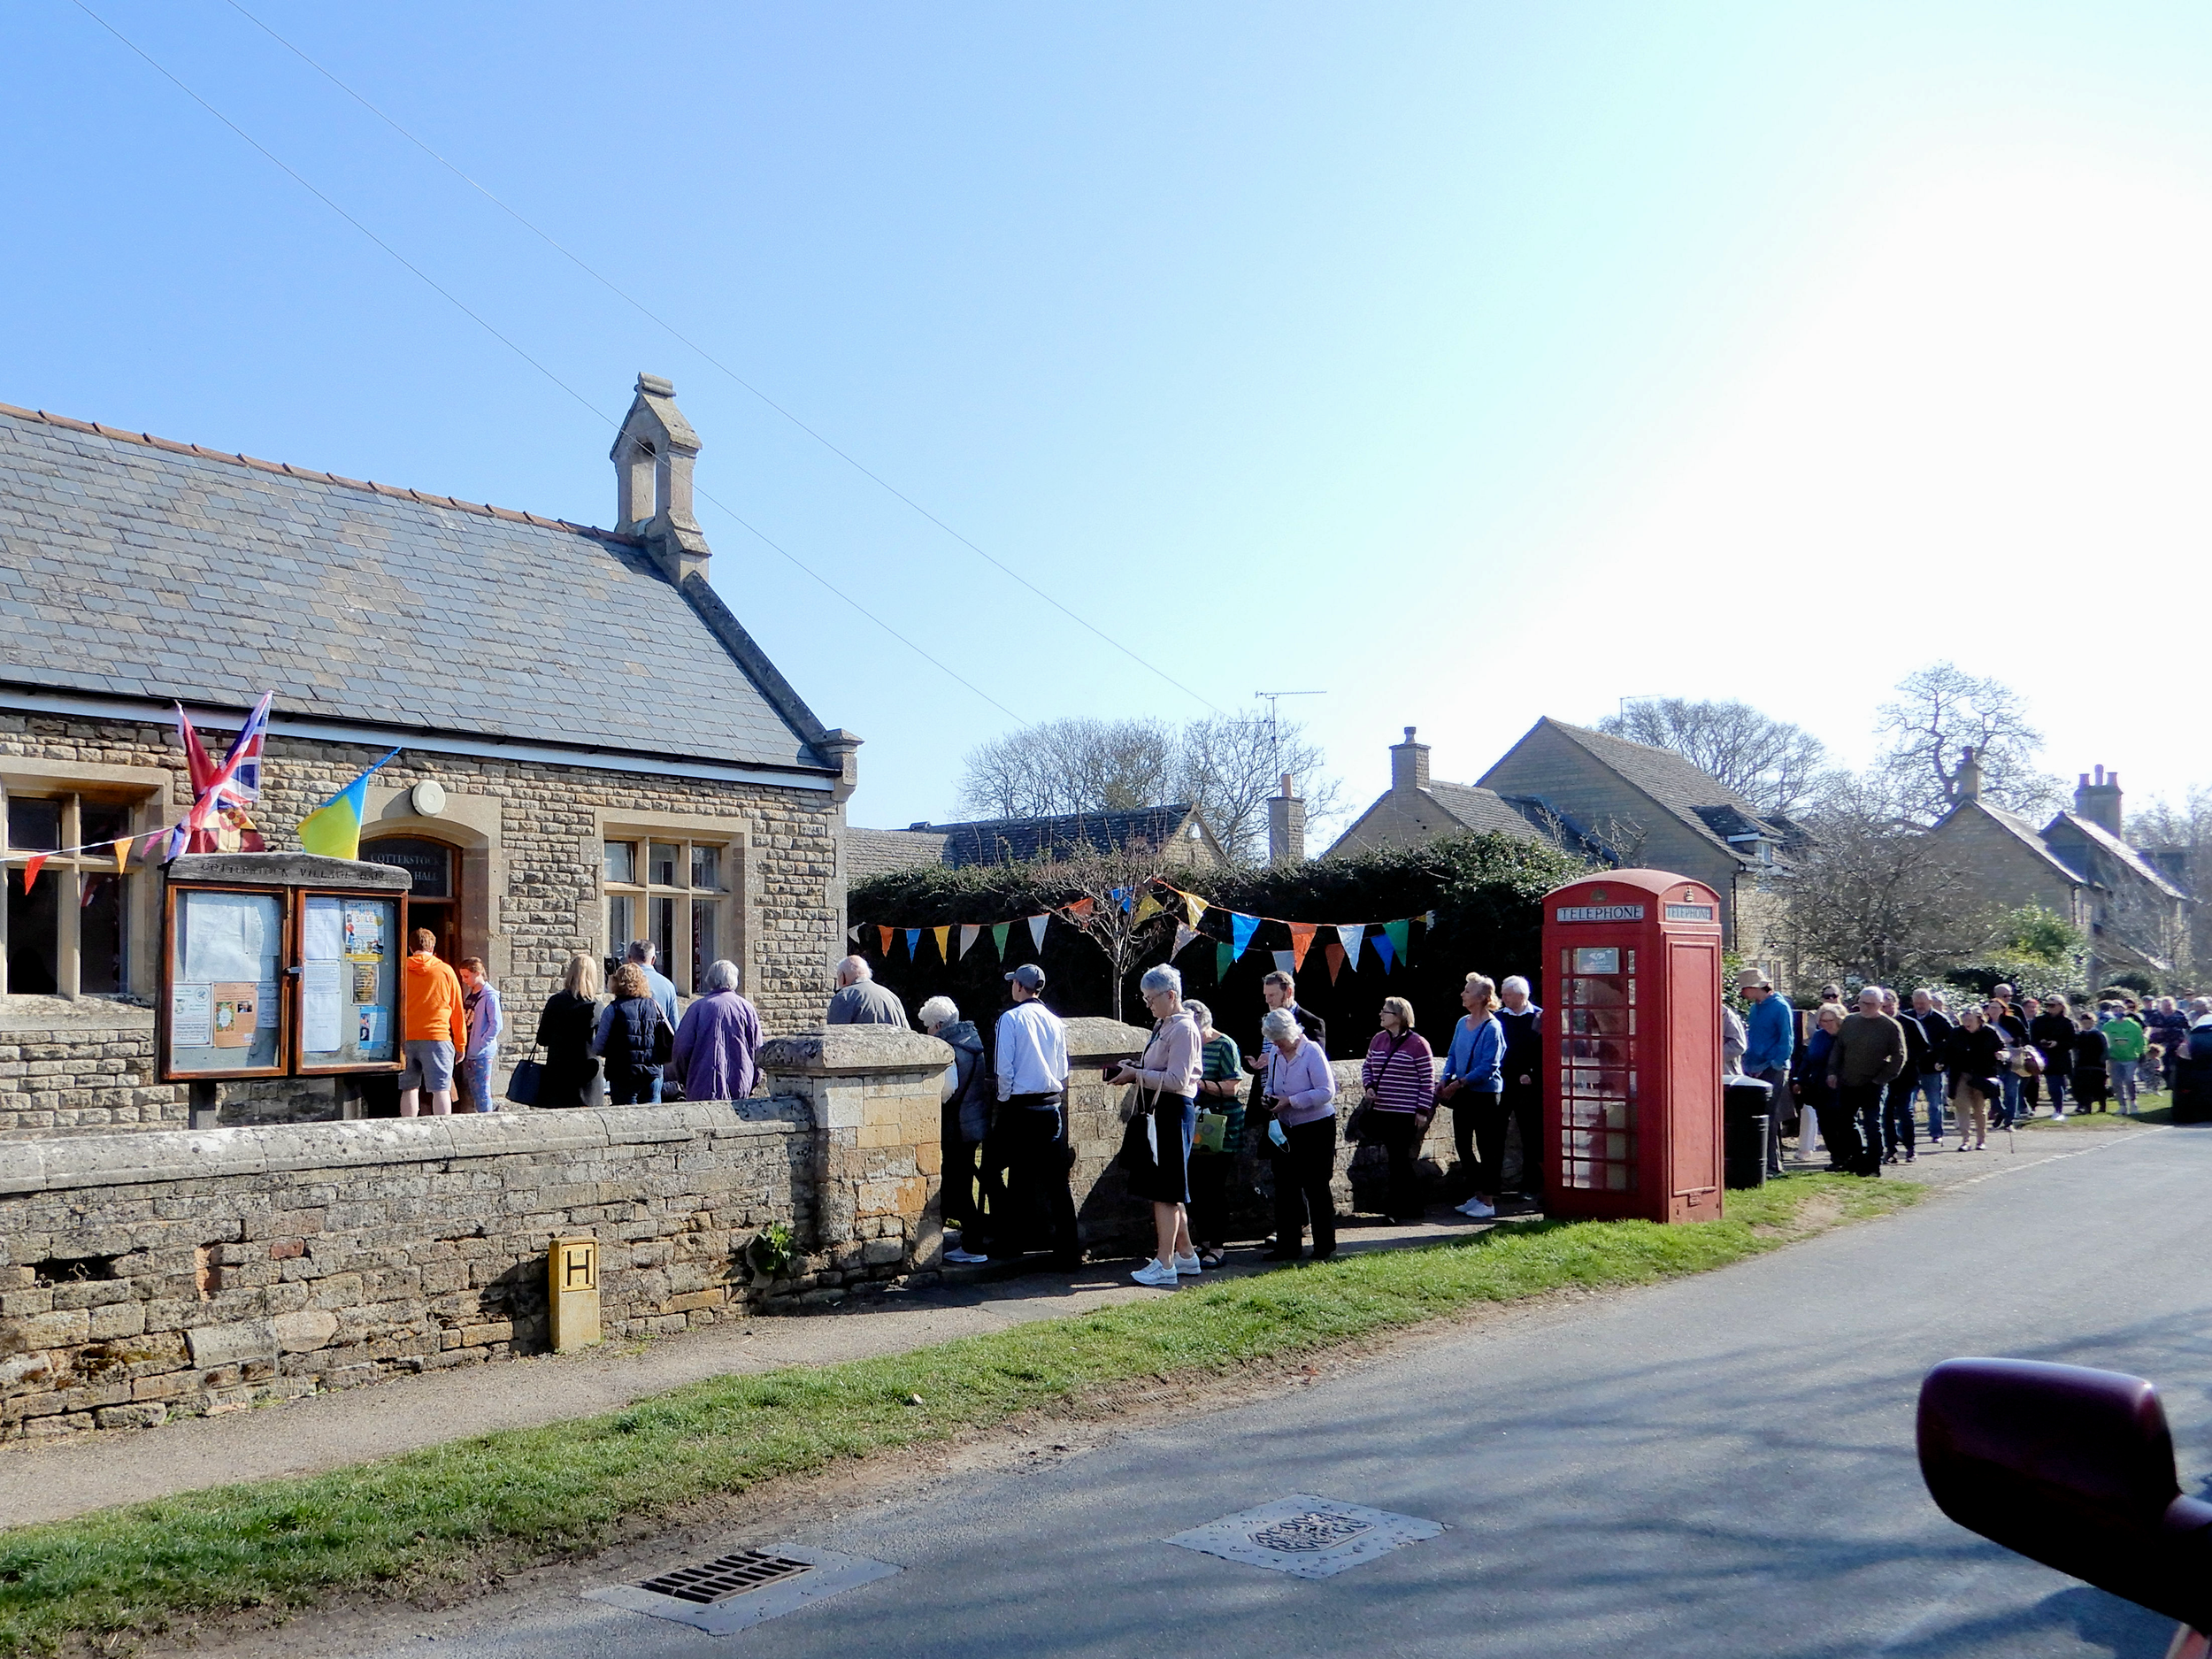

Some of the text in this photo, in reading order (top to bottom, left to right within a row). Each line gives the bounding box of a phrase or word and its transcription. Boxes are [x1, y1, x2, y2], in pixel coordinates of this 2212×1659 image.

[371, 853, 440, 864] COTTERSTOCK
[300, 868, 351, 879] VILLAGE
[414, 871, 438, 881] HALL
[1562, 906, 1641, 919] TELEPHONE
[1667, 905, 1710, 919] TELEPHONE
[567, 1249, 589, 1286] H
